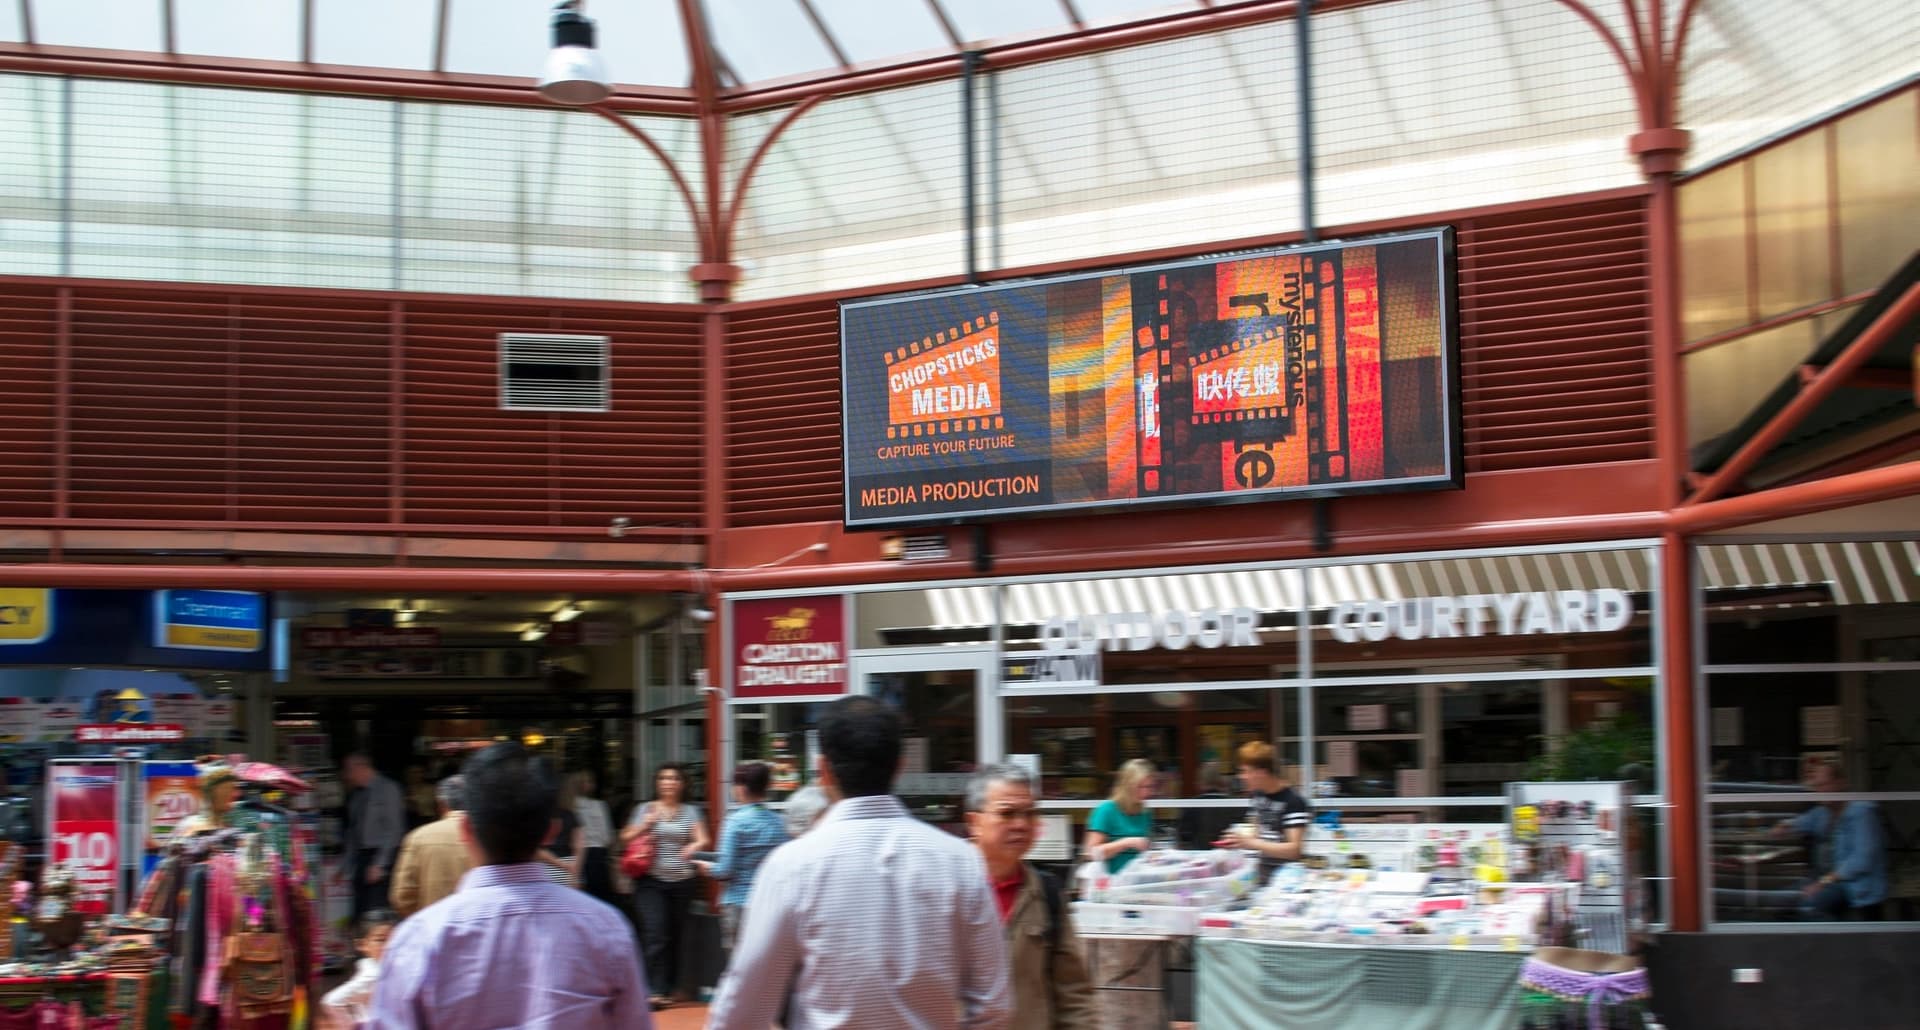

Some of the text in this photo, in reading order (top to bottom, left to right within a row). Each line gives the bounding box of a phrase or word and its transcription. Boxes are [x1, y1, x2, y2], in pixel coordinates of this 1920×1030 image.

[890, 338, 997, 393] CHOPSTICKS
[1197, 361, 1280, 401] 快传媒
[912, 382, 992, 416] MEDIA
[878, 434, 1016, 459] CAPTURE YOUR FUTURE
[861, 475, 1039, 507] MEDIA PRODUCTION
[1040, 607, 1263, 651] OUTDOOR
[1331, 588, 1634, 642] COURTYARD
